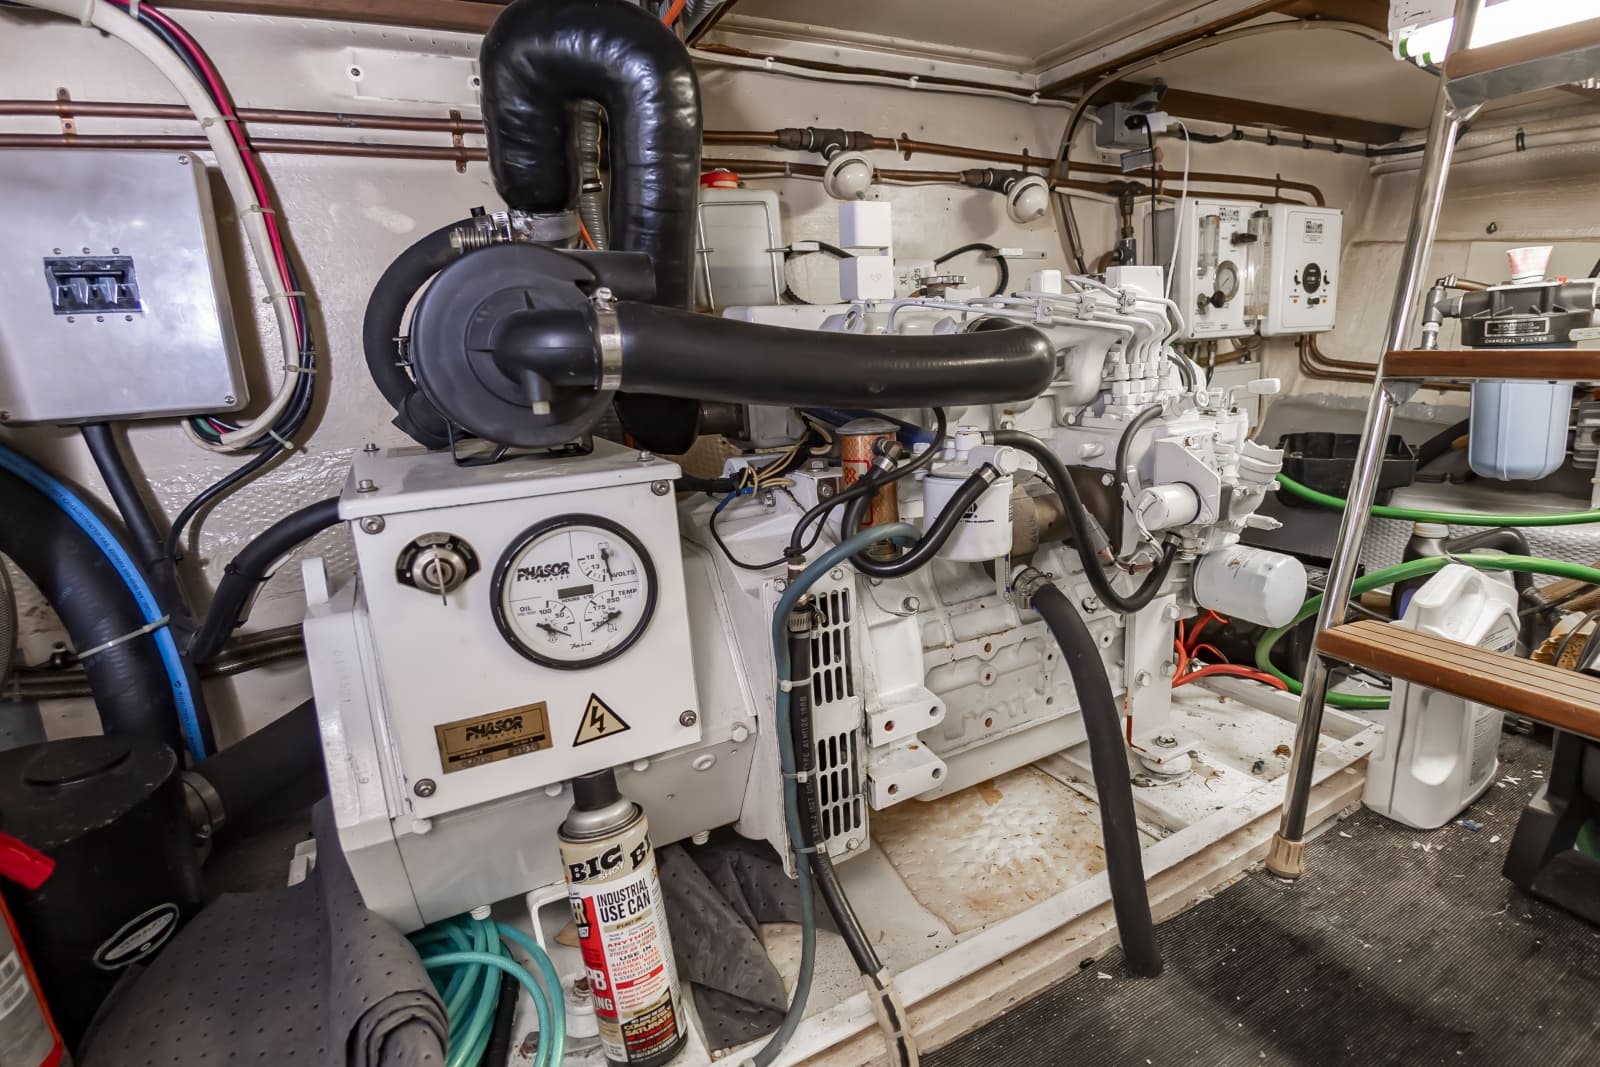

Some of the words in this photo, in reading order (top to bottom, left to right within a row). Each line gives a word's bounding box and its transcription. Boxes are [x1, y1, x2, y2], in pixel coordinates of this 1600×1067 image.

[516, 562, 570, 582] PHASOR
[618, 588, 638, 596] TEMP
[465, 716, 523, 742] PHASOR
[568, 844, 623, 882] BIG
[596, 876, 648, 908] INDUSTRIAL
[600, 905, 626, 923] USE
[628, 892, 651, 916] CAN
[620, 950, 640, 962] USE
[642, 944, 652, 953] IN
